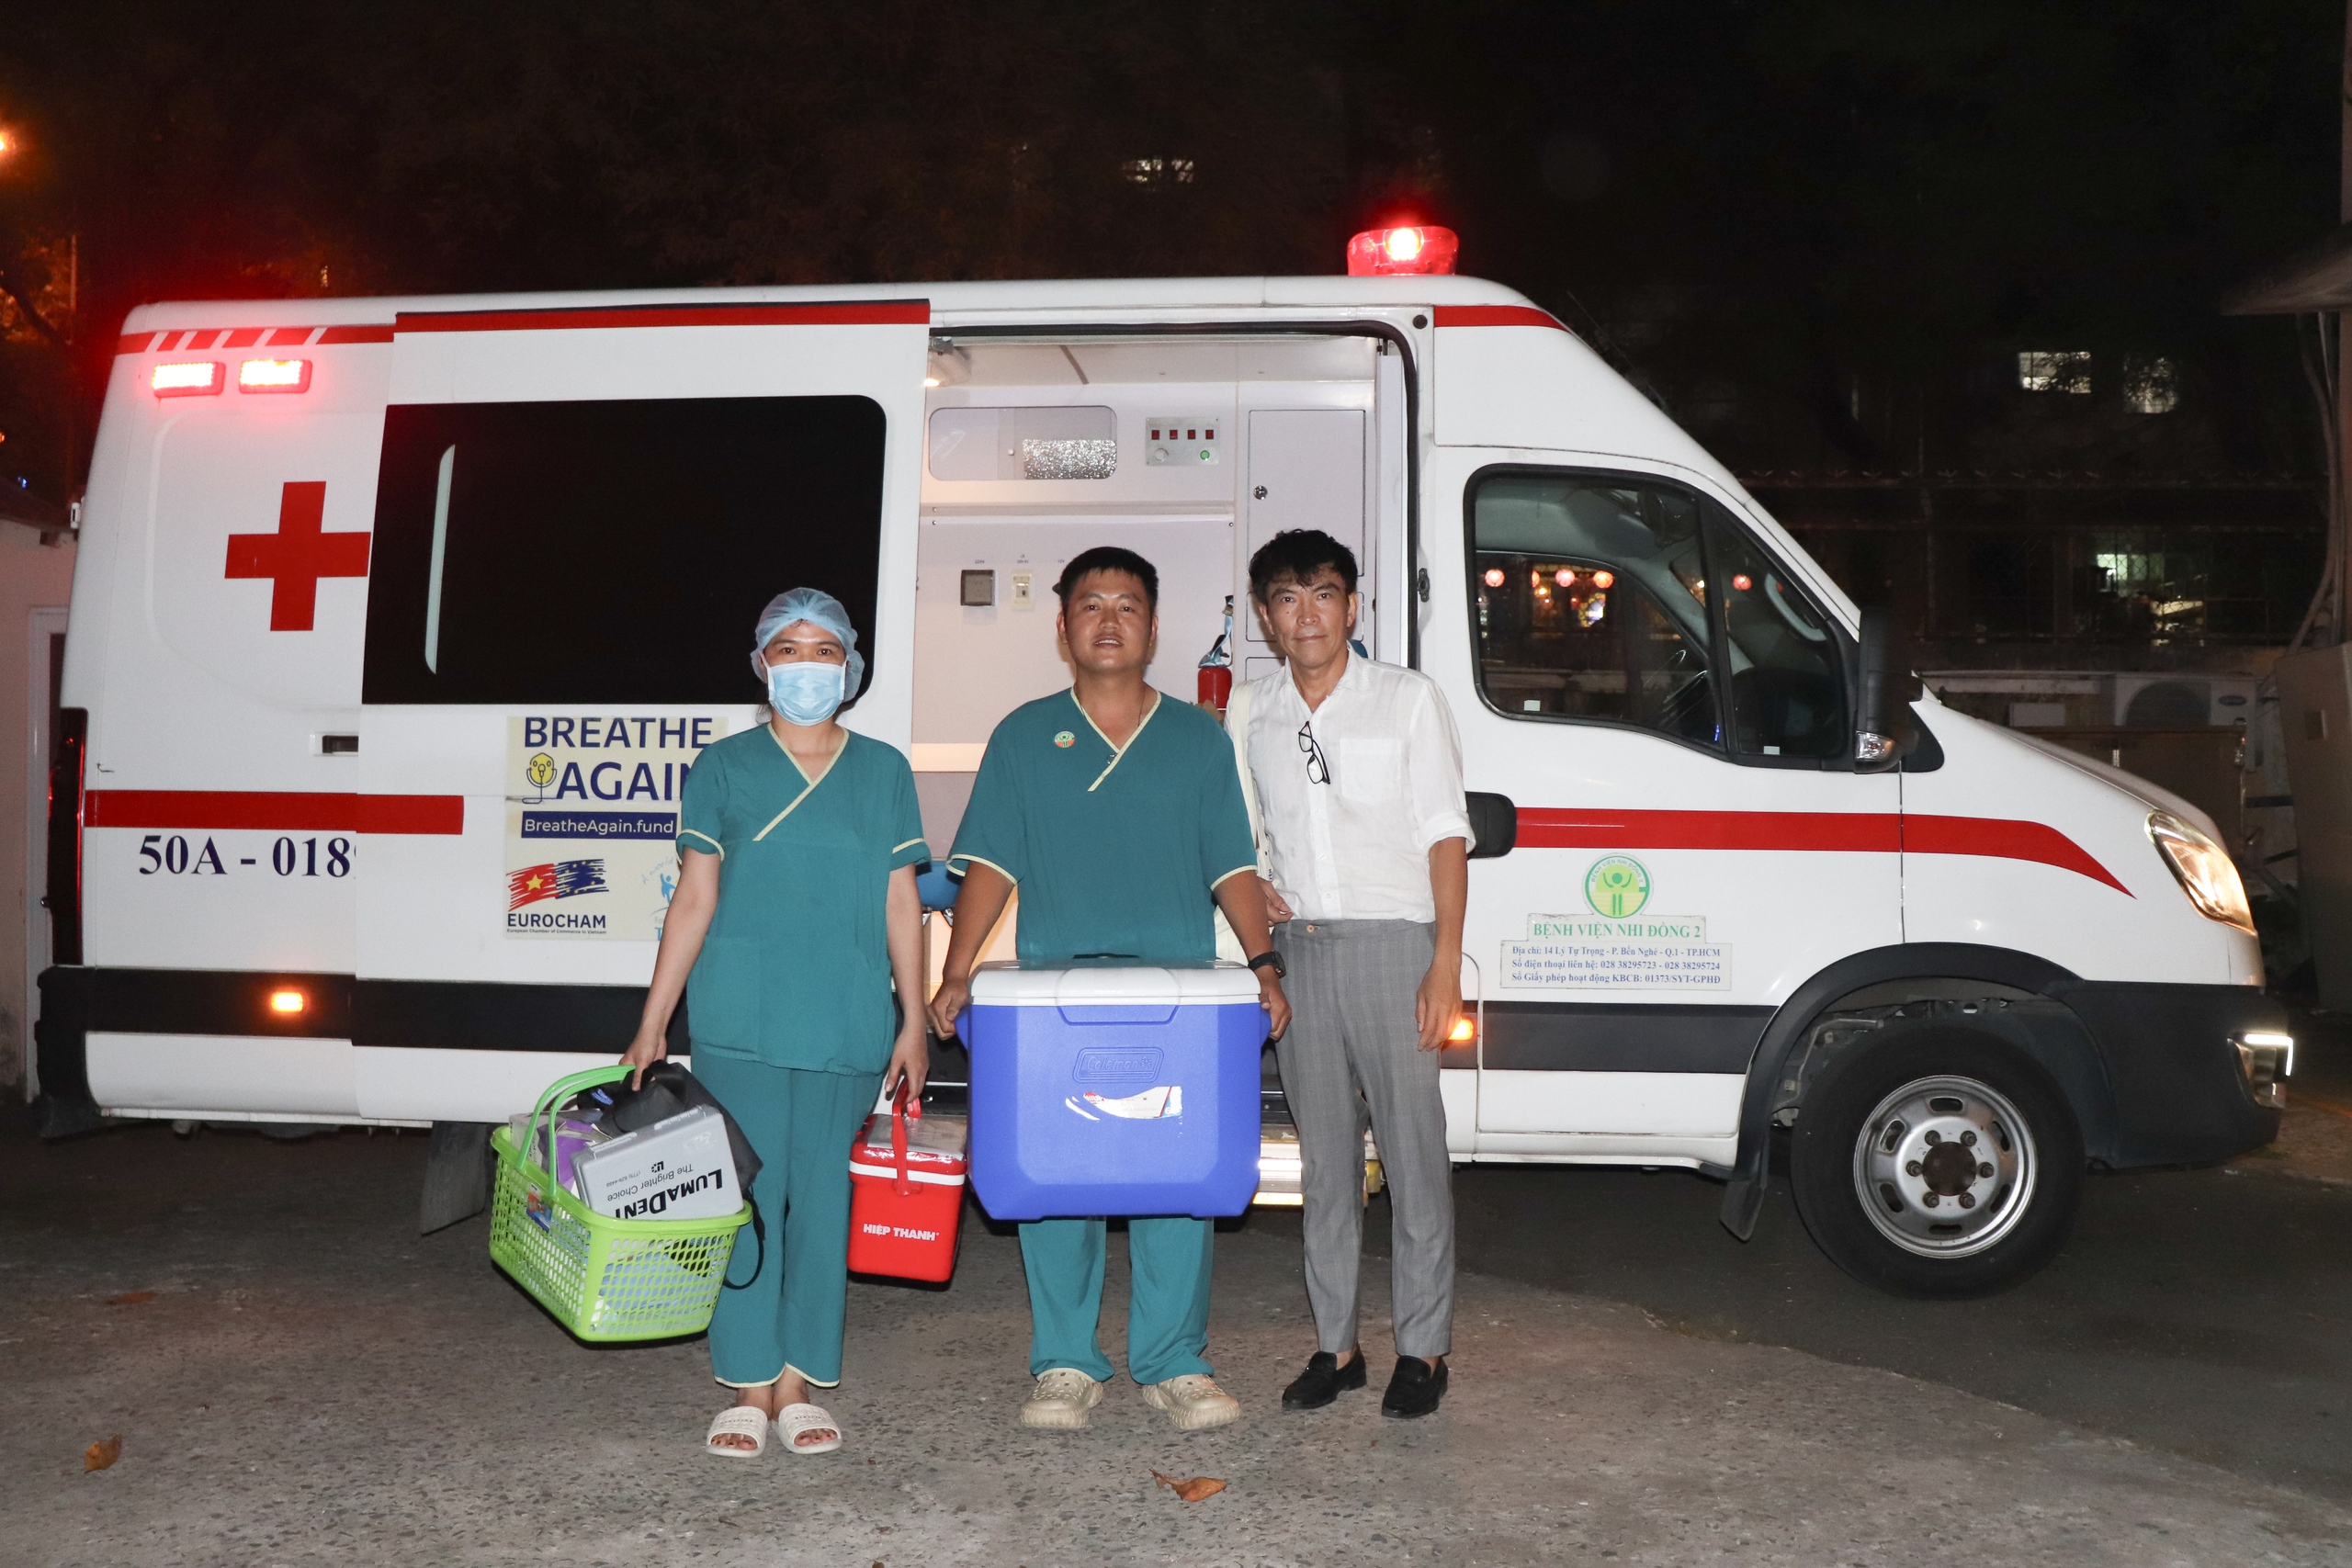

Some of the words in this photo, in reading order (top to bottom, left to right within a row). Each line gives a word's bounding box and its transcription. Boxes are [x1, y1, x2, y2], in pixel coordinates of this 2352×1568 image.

[525, 716, 713, 749] BREATHE
[525, 818, 674, 836] BreatheAgain.fund
[139, 835, 228, 874] 50A
[273, 837, 356, 878] 018
[507, 913, 606, 929] EUROCHAM
[1533, 921, 1573, 939] BỆNH
[1577, 921, 1612, 939] VIỆN
[1617, 924, 1643, 937] NHI
[1694, 926, 1701, 938] 2
[1544, 946, 1553, 954] 14
[1581, 947, 1604, 956] Trọng
[1611, 947, 1619, 955] P.
[1665, 948, 1679, 957] Q.1
[1686, 948, 1720, 956] TP.HCM
[1544, 960, 1566, 969] thoại
[1567, 960, 1583, 968] liên
[1600, 961, 1615, 969] 028
[1617, 961, 1657, 969] 38295723
[1665, 962, 1679, 970] 028
[1681, 962, 1720, 970] 38295724
[1568, 974, 1587, 983] hoạt
[1589, 974, 1610, 984] động
[1612, 974, 1643, 983] KBCB:
[1087, 1056, 1138, 1070] Coleman
[677, 1164, 694, 1175] The
[640, 1170, 674, 1190] Brighter
[607, 1185, 639, 1201] Choice
[864, 1224, 891, 1236] HIỆP
